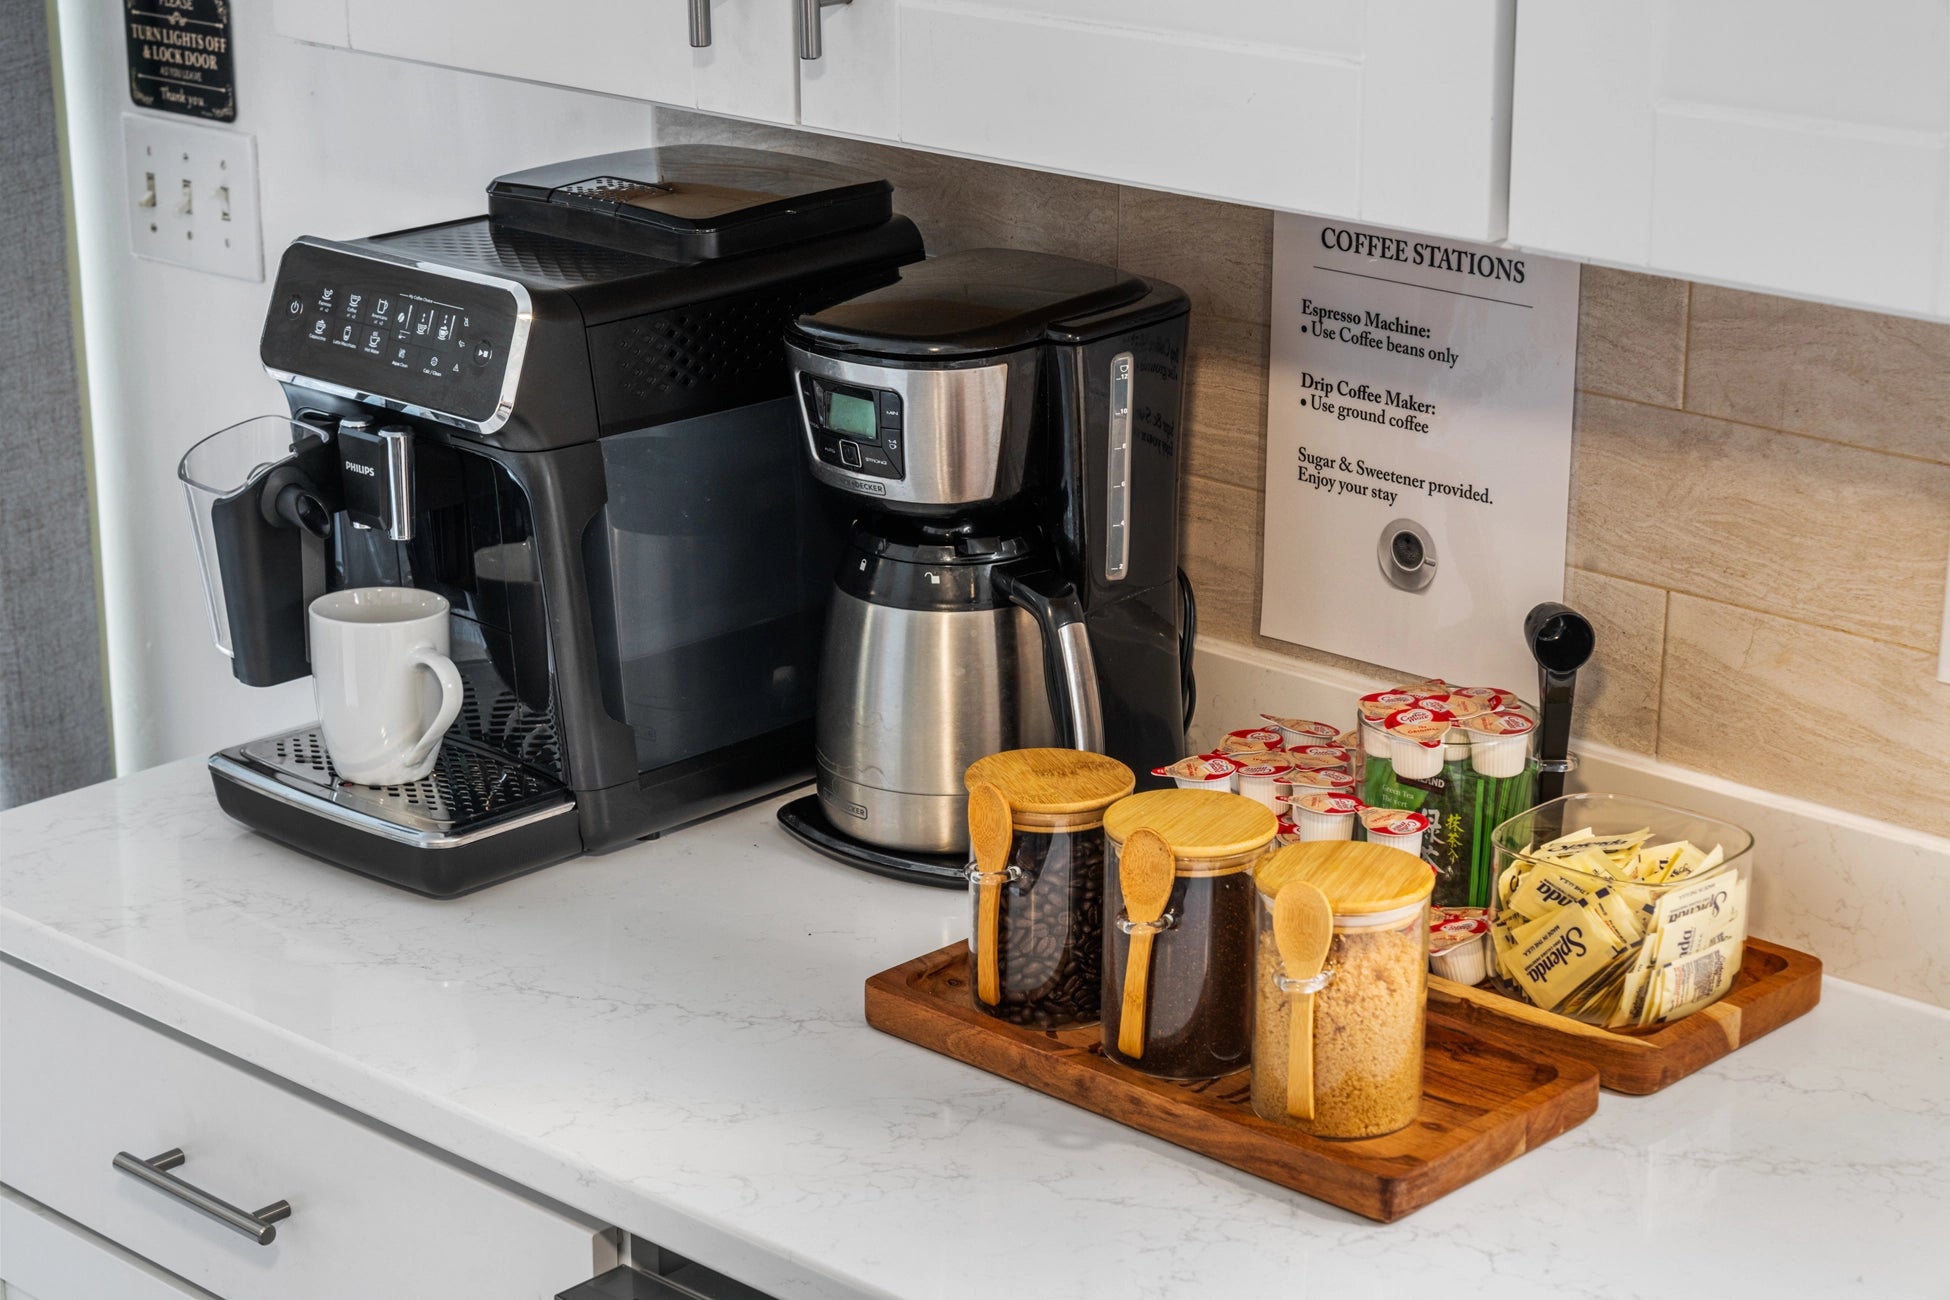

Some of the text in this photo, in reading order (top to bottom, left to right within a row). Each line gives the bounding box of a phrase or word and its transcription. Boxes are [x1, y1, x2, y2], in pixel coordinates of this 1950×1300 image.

[131, 24, 226, 53] TURN LIGHTS OFF
[143, 45, 218, 70] & LOCK DOOR
[160, 86, 186, 103] Thank
[1321, 227, 1525, 284] COFFEE STATIONS
[1301, 299, 1431, 339] Espresso Machine:
[1311, 320, 1460, 369] Use Coffee beans only
[1301, 372, 1436, 415] Drip Coffee Maker:
[1120, 407, 1128, 415] 10
[1311, 394, 1429, 434] Use ground coffee
[345, 461, 375, 476] PHILIPS
[865, 457, 887, 465] STRONG
[1298, 446, 1494, 505] Sugar & Sweetener provided.
[1297, 465, 1398, 507] Enjoy your stay
[1382, 784, 1414, 800] Green Tea
[1532, 938, 1544, 949] THE
[1546, 924, 1562, 938] MADE
[1525, 926, 1587, 983] Splenda
